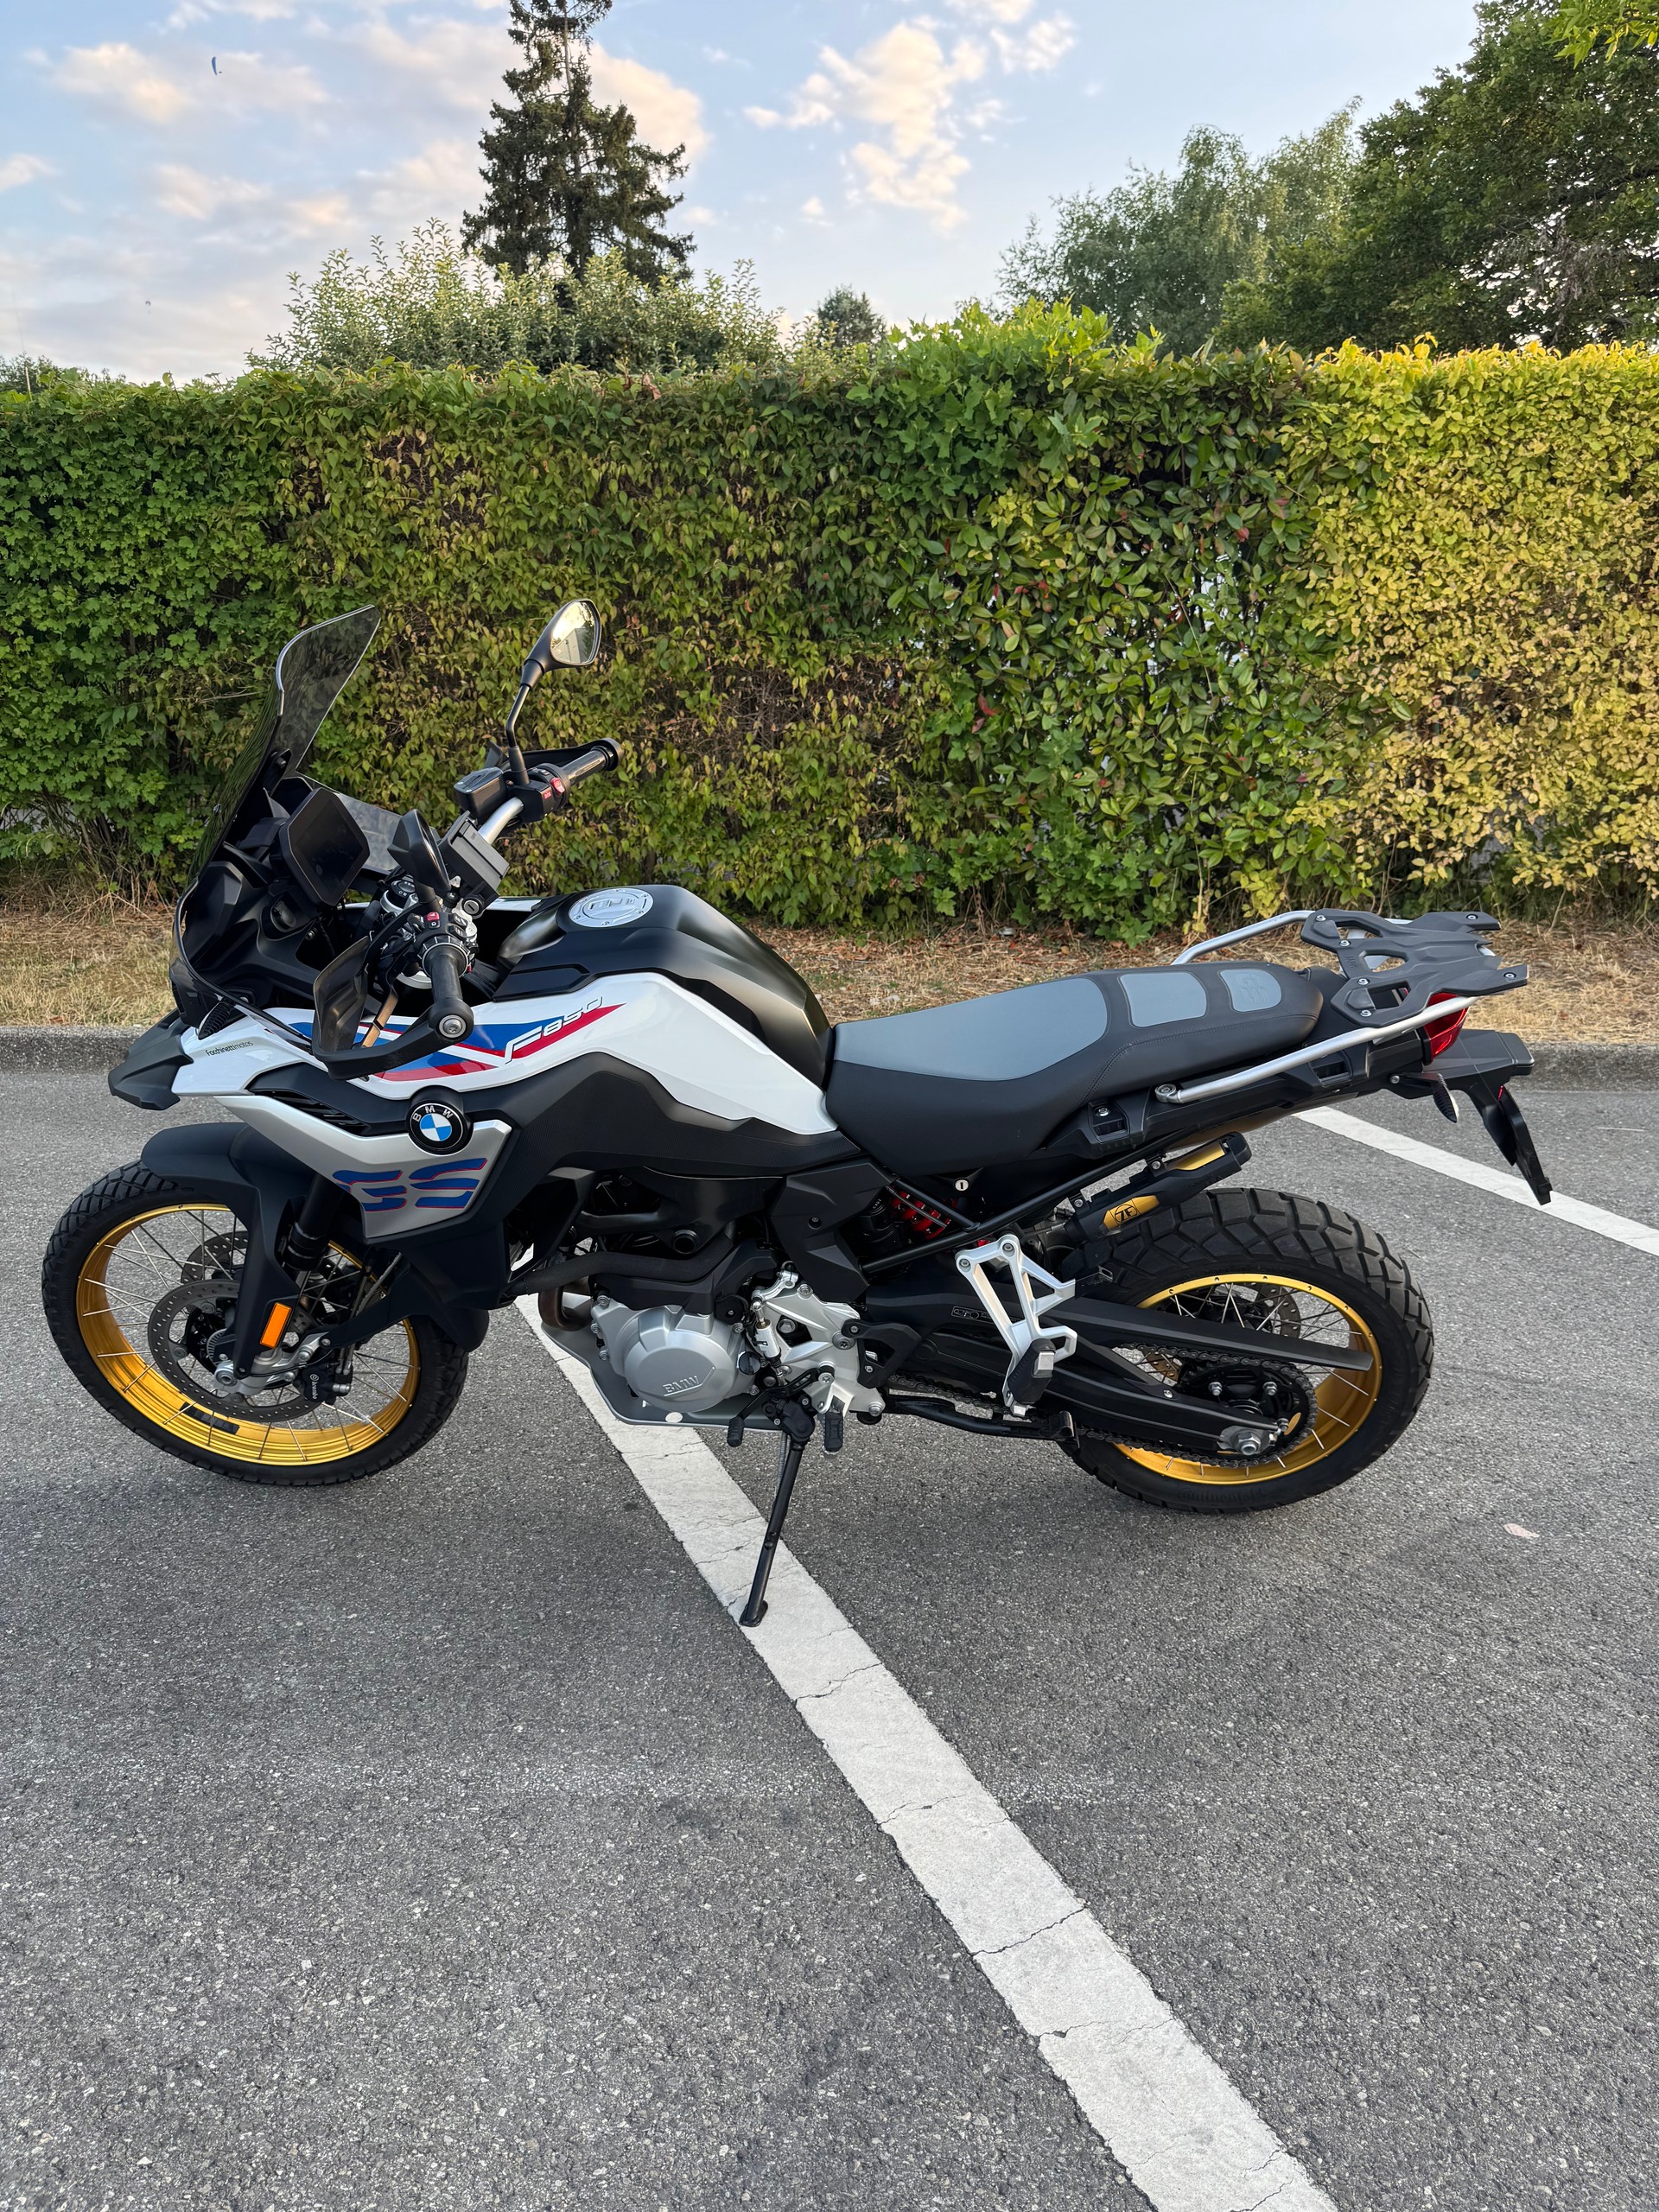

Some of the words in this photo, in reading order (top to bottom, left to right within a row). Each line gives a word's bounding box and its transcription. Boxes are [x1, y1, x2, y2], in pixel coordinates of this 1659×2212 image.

[412, 1105, 454, 1122] BMW
[332, 1158, 487, 1212] GS
[663, 1375, 699, 1393] BMW
